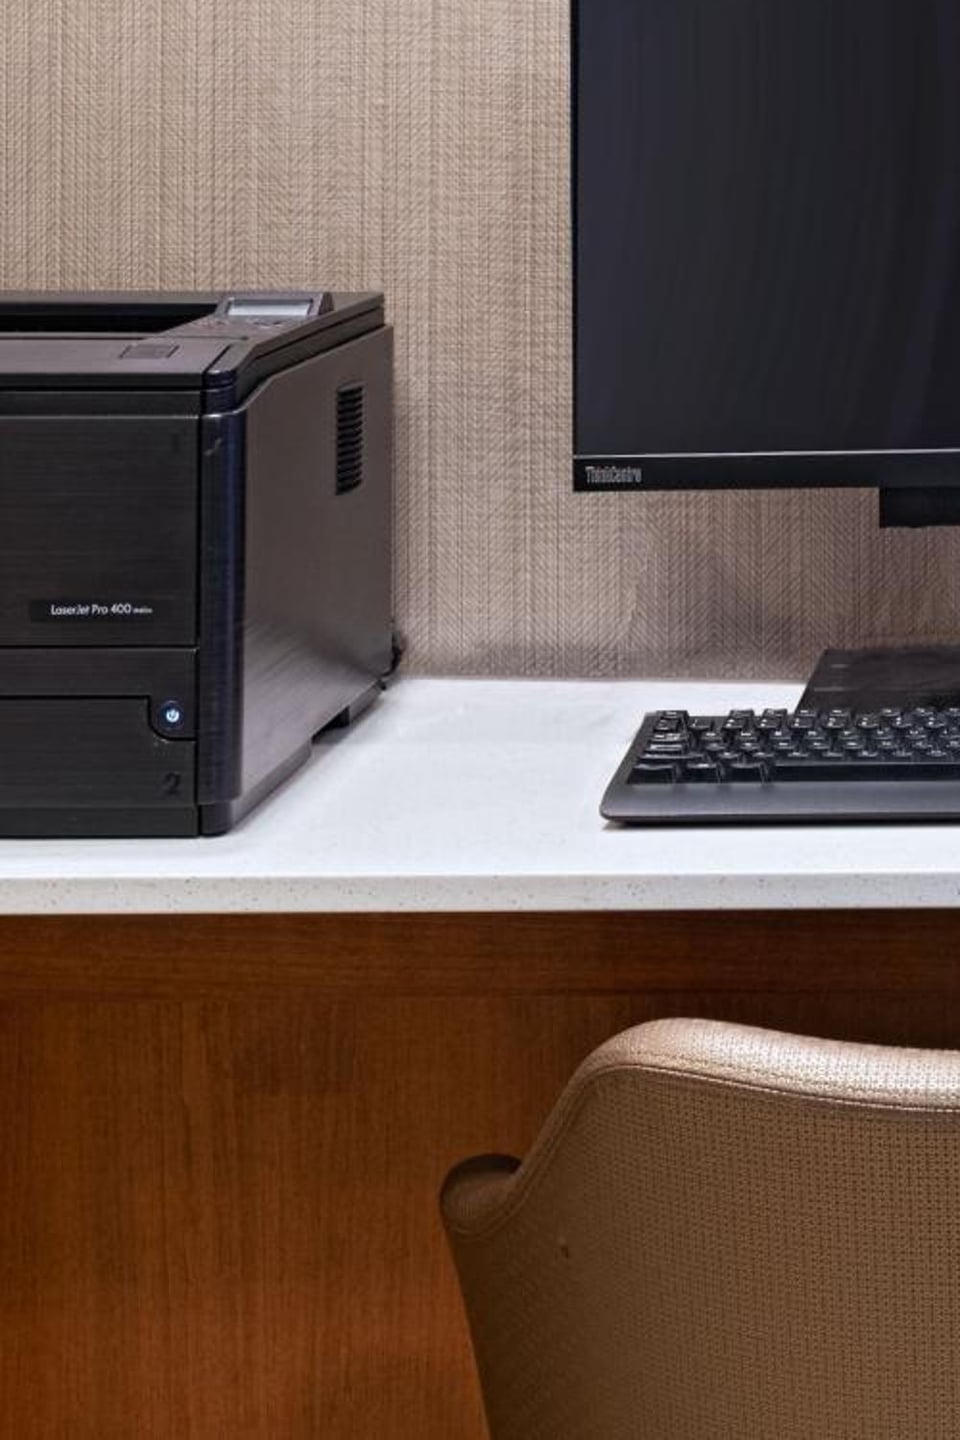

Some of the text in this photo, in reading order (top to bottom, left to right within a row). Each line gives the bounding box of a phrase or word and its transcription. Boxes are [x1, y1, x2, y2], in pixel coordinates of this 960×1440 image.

[50, 604, 90, 615] LaserJet
[91, 604, 108, 615] Pro
[110, 603, 132, 614] 400
[163, 772, 182, 795] 2
